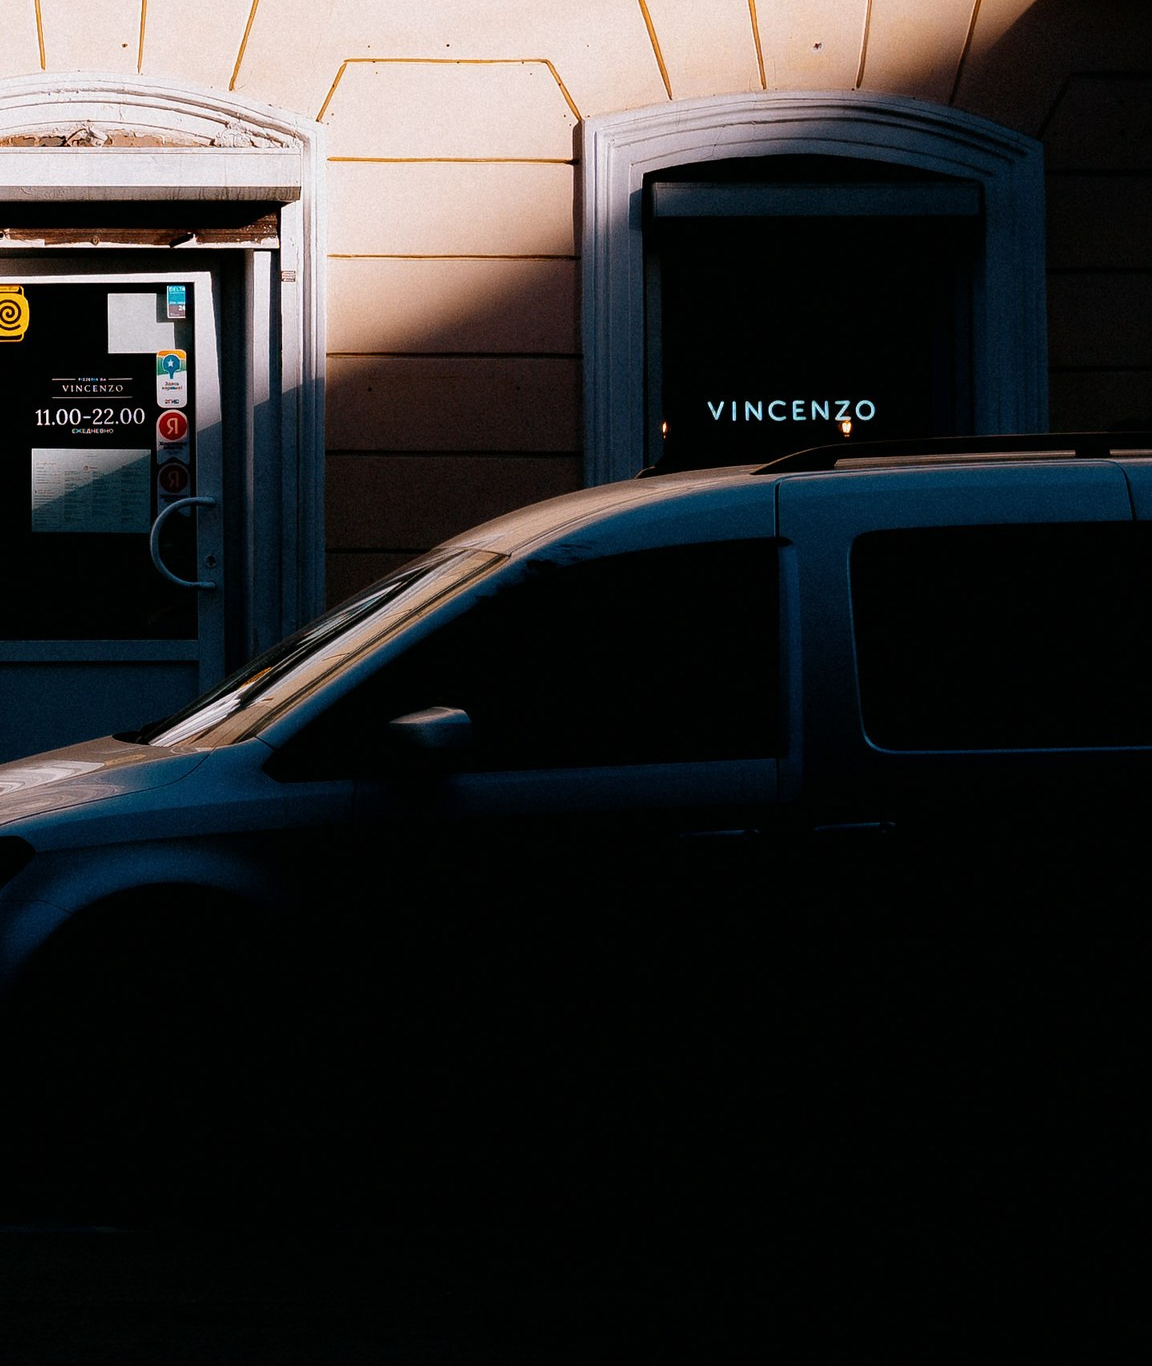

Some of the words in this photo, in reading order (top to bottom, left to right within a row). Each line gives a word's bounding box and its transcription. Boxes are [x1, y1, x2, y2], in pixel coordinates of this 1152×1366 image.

[62, 384, 124, 393] VINCENZO
[35, 407, 146, 426] 11.00-22.00
[707, 399, 876, 422] VINCENZO
[166, 417, 179, 435] Я
